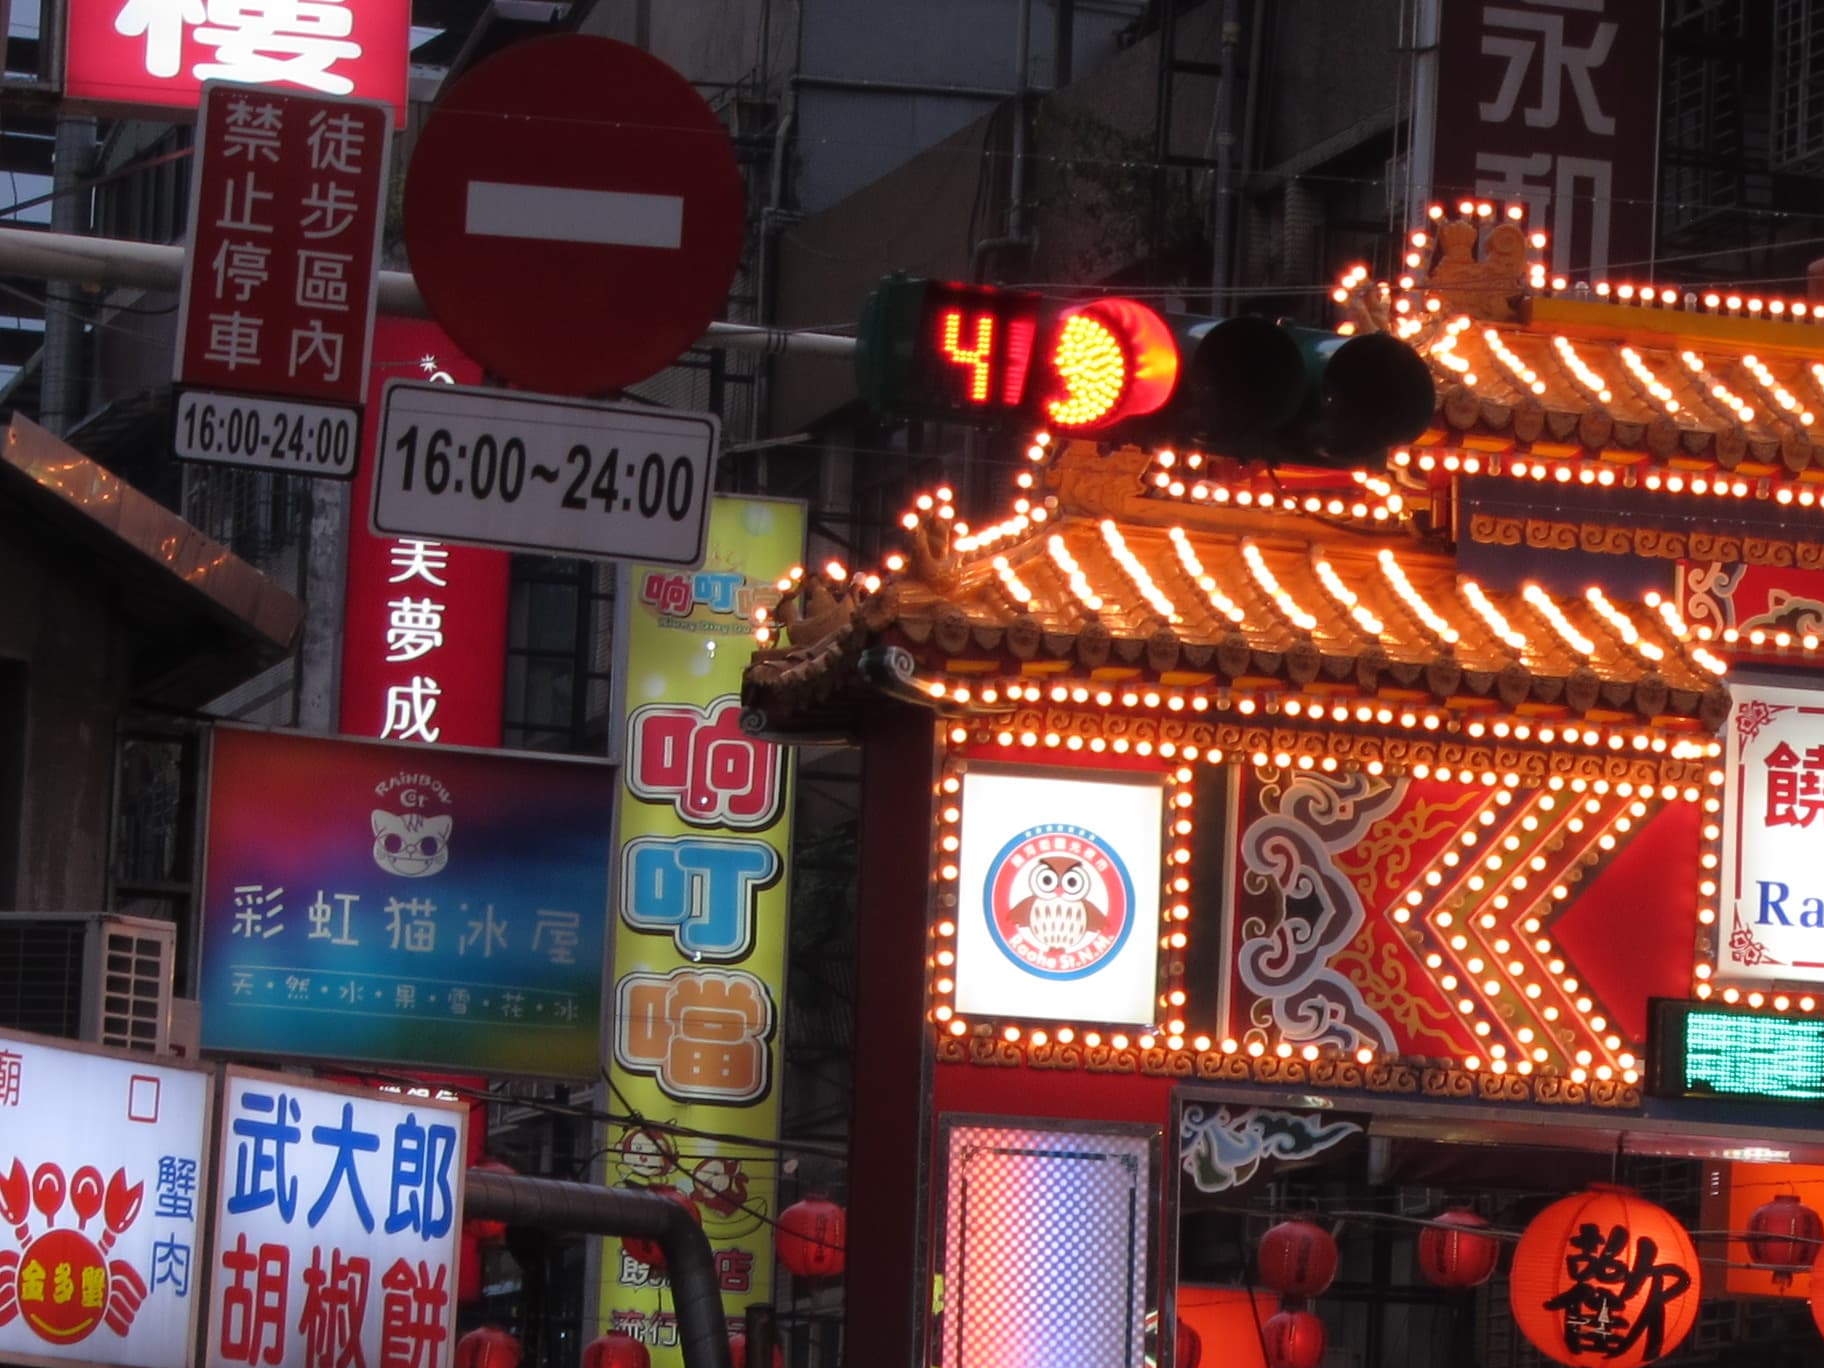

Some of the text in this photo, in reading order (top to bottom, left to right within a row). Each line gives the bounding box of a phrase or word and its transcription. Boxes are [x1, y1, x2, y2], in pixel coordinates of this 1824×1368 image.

[204, 99, 284, 371] 禁止停車
[288, 109, 366, 384] 徒步區內
[183, 403, 350, 470] 16:00-24:00
[395, 426, 695, 522] 16:00~24:00
[151, 1155, 197, 1298] 蟹肉
[227, 1092, 459, 1242] 武大郎
